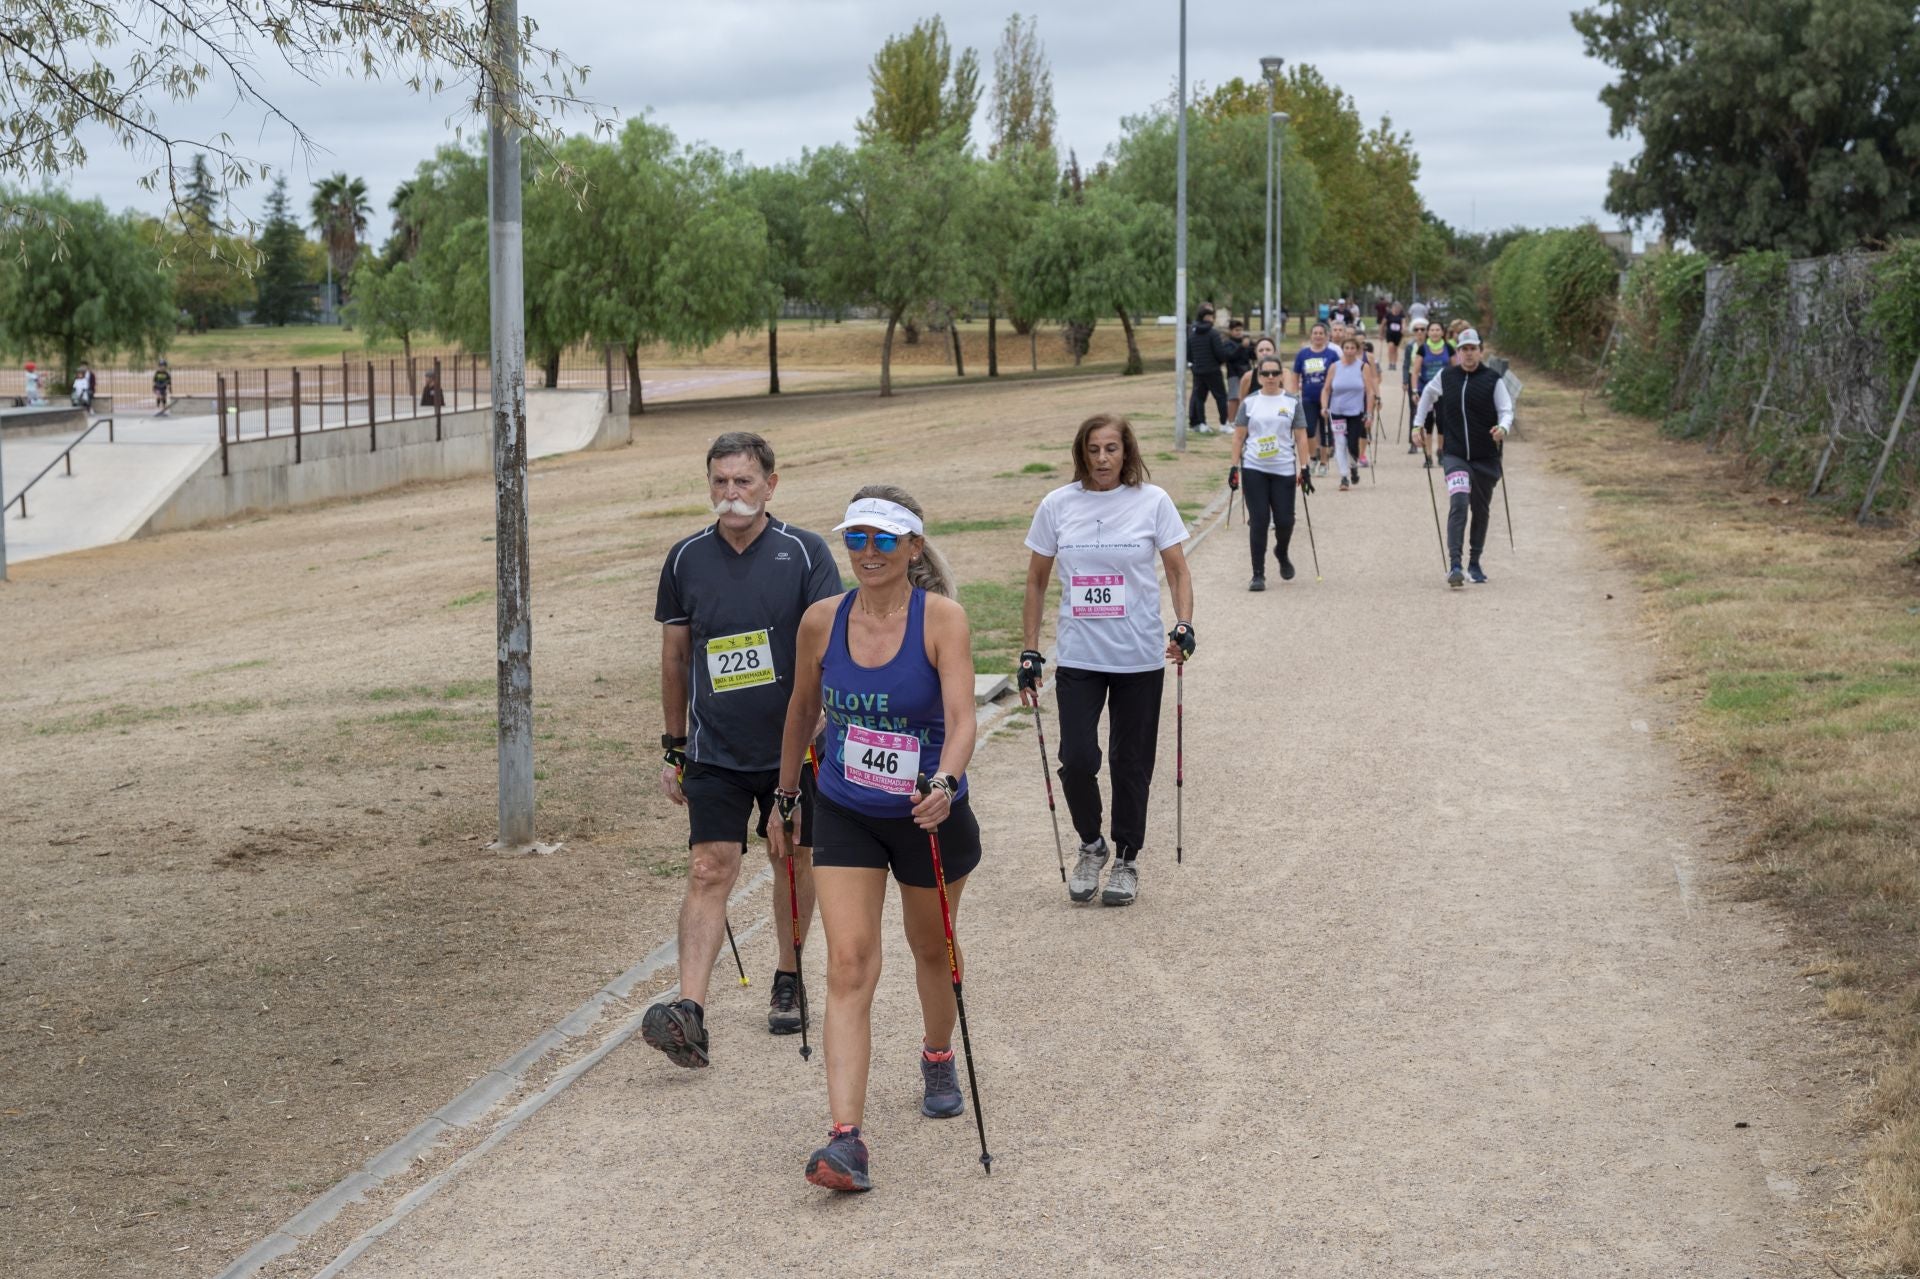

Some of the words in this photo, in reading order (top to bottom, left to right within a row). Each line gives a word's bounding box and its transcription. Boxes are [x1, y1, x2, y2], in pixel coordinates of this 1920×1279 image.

[1259, 441, 1275, 452] 222
[1084, 587, 1111, 604] 436
[718, 649, 760, 675] 228
[736, 670, 771, 680] EXTREMADURA
[835, 690, 889, 713] LOVE
[861, 748, 899, 775] 446
[873, 774, 911, 787] EXTREMADURA
